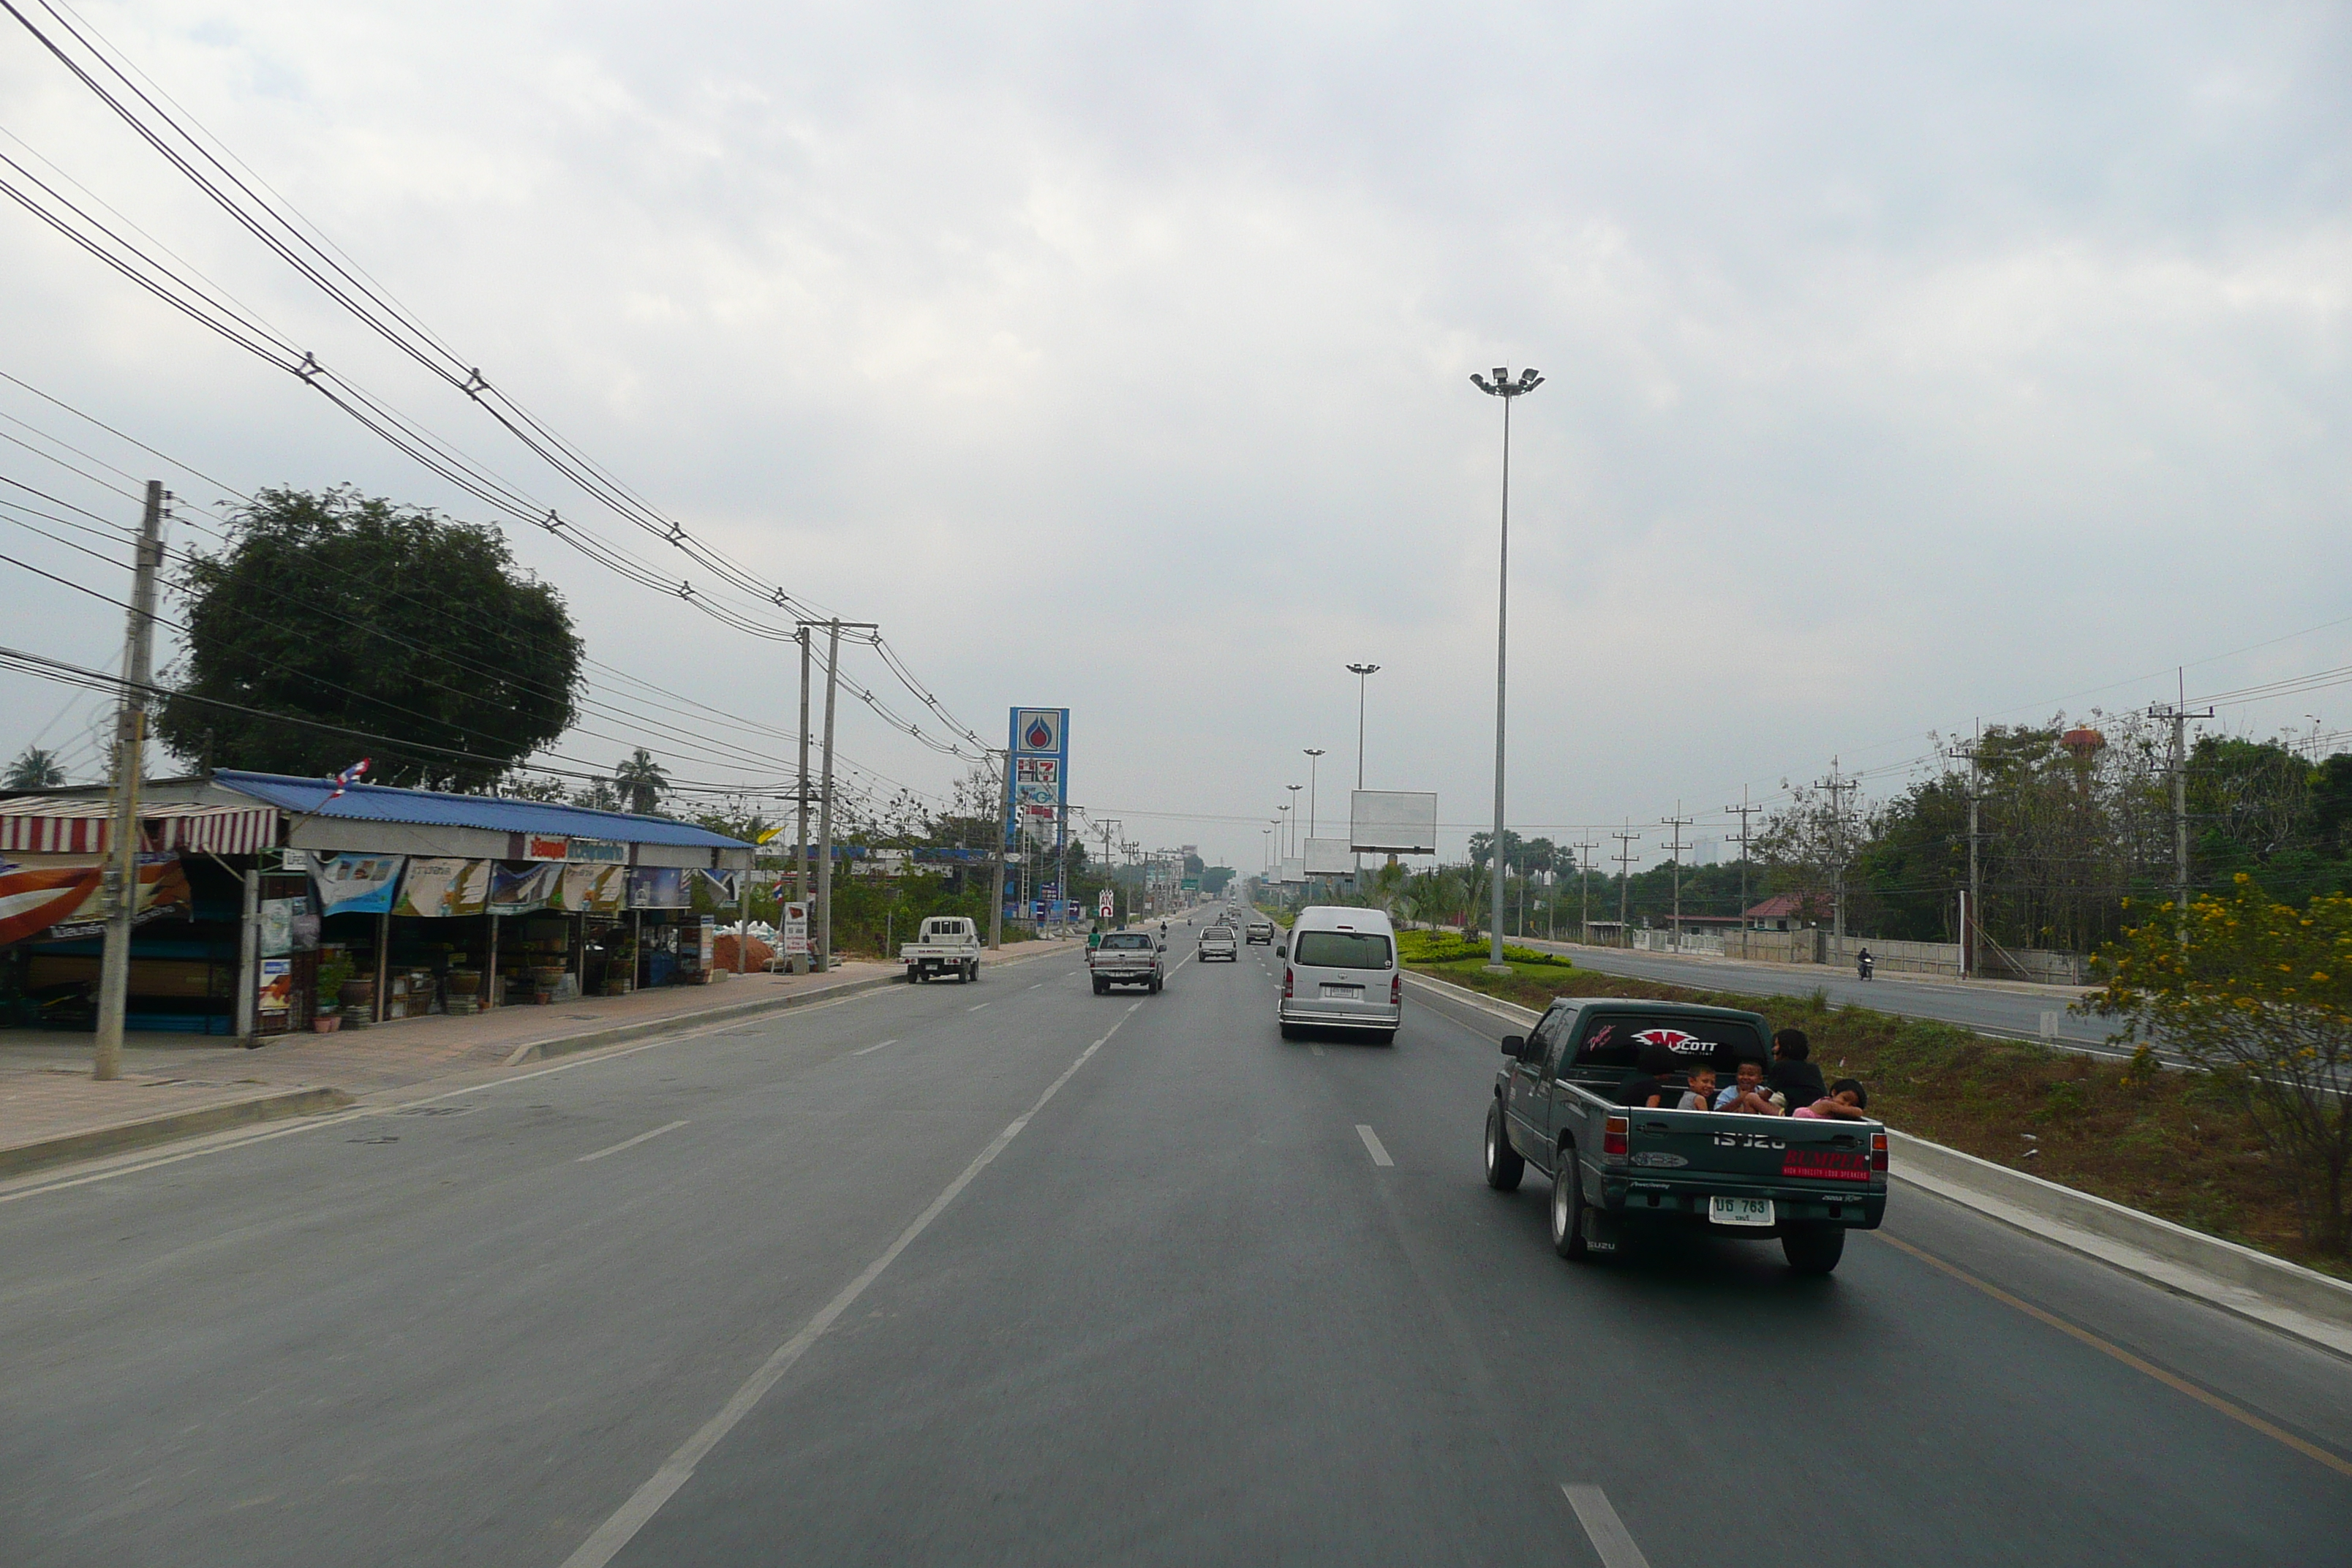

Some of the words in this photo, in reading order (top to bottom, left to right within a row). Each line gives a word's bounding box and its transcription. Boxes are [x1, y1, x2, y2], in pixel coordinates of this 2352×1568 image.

[1784, 1150, 1866, 1169] BUMPER
[1784, 1166, 1796, 1175] HIGH
[1798, 1168, 1823, 1176] FIDELITY
[1840, 1171, 1866, 1180] SPEAKERS
[1742, 1200, 1765, 1213] 763
[1587, 1240, 1615, 1250] SUZU
